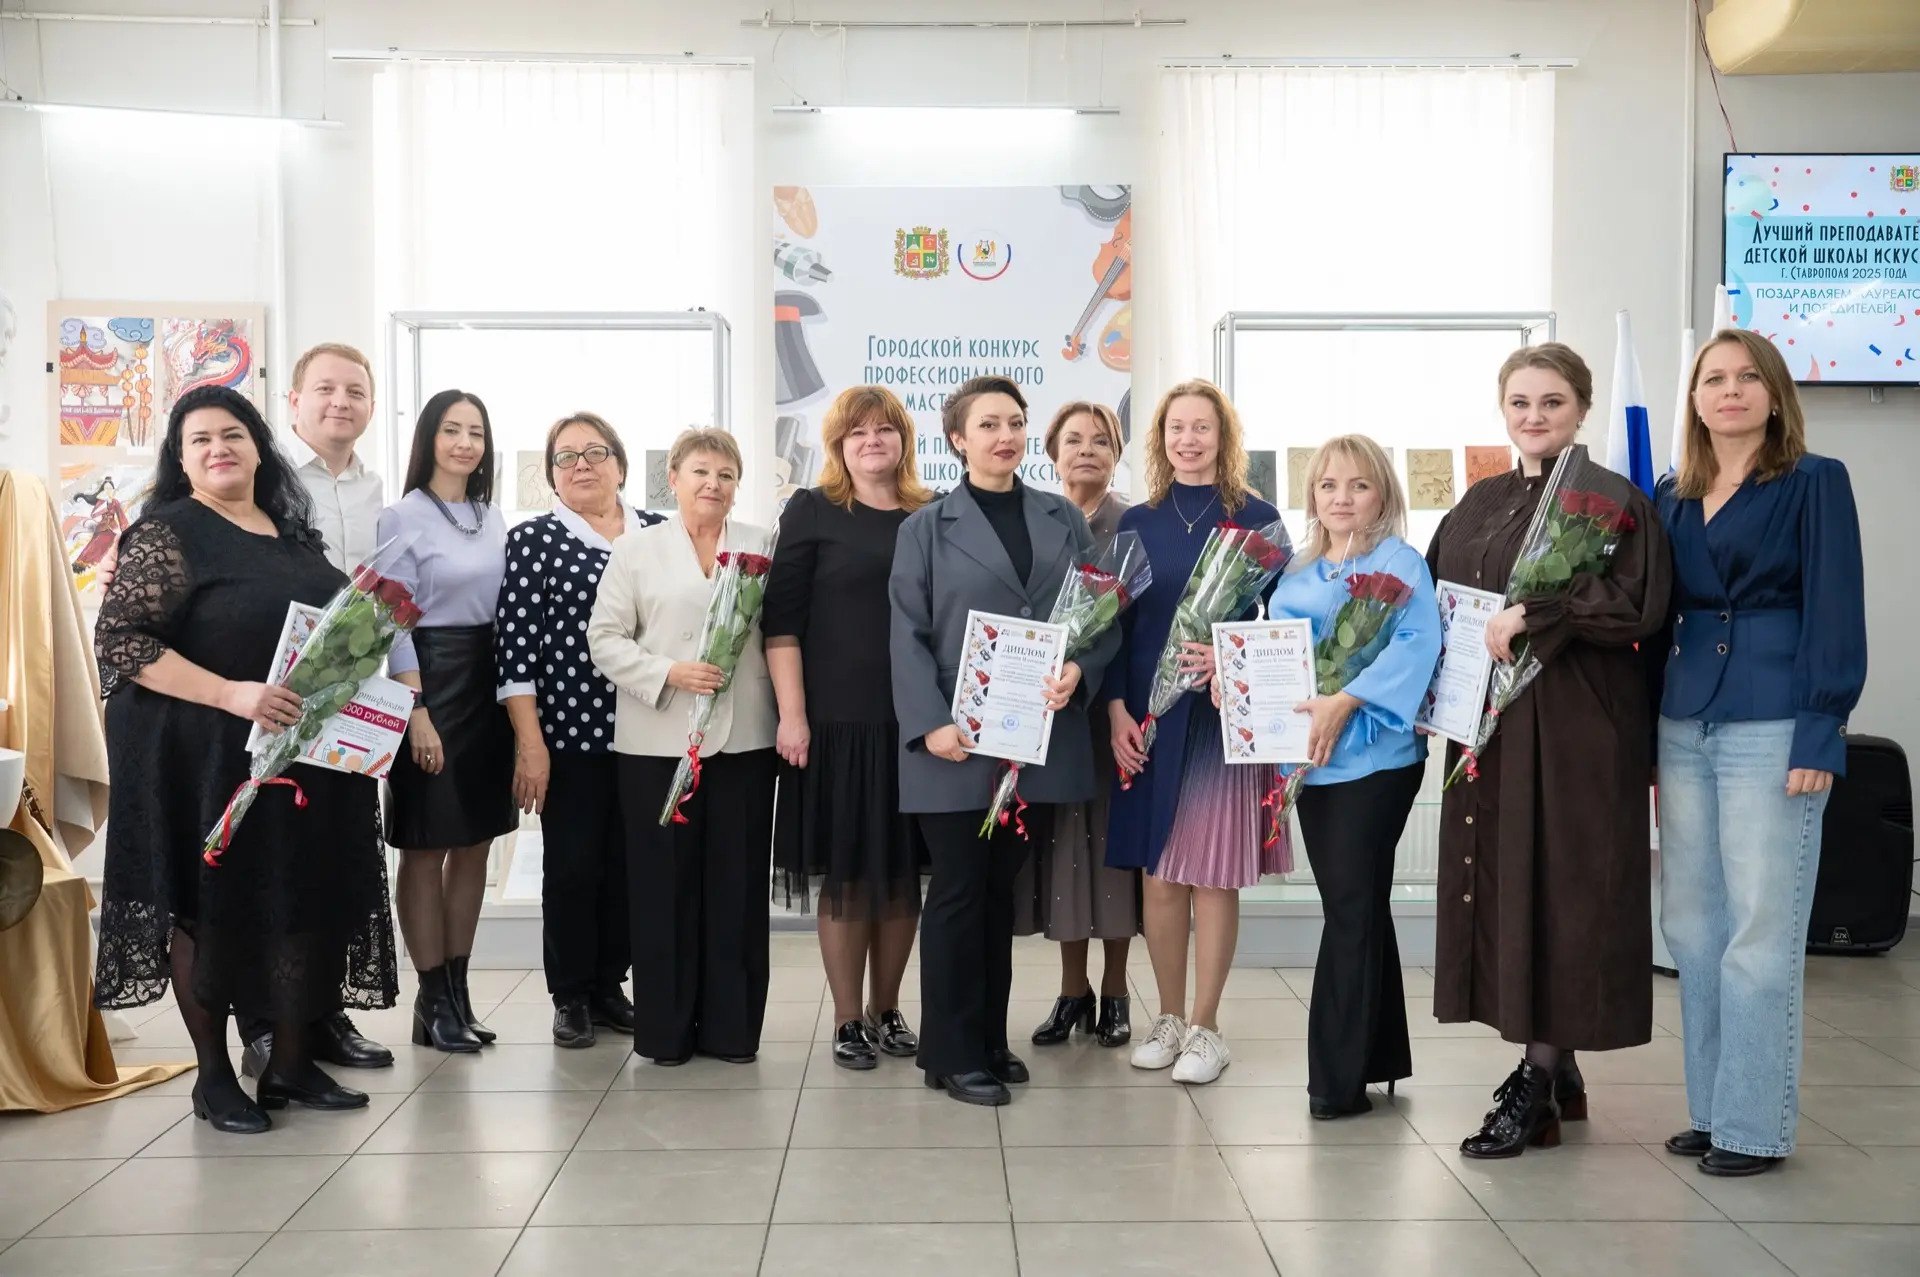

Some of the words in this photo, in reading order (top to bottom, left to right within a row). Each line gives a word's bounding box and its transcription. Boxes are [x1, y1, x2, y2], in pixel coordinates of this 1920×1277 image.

[1752, 221, 1813, 244] ЛУЧШИЙ
[1744, 245, 1807, 264] ДЕТСКОЙ
[1813, 248, 1868, 264] ШКОЛЫ
[1874, 248, 1919, 264] ИСКУС
[1791, 265, 1849, 280] СТАВРОПОЛЯ
[1852, 268, 1881, 279] 2025
[1884, 268, 1907, 279] ГОДА
[1756, 288, 1851, 299] ПОЗДРАВЛЯЕМ
[1861, 288, 1920, 299] АУРЕАТО
[1789, 303, 1798, 313] И
[868, 335, 962, 361] ГОРОДСКОЙ
[969, 339, 1040, 358] КОНКУРС
[923, 462, 964, 481] ШКО
[1002, 644, 1046, 659] ДИПЛОМ
[1252, 647, 1294, 657] ДИПЛОМ
[356, 691, 405, 713] ртификат
[363, 711, 400, 729] рублей
